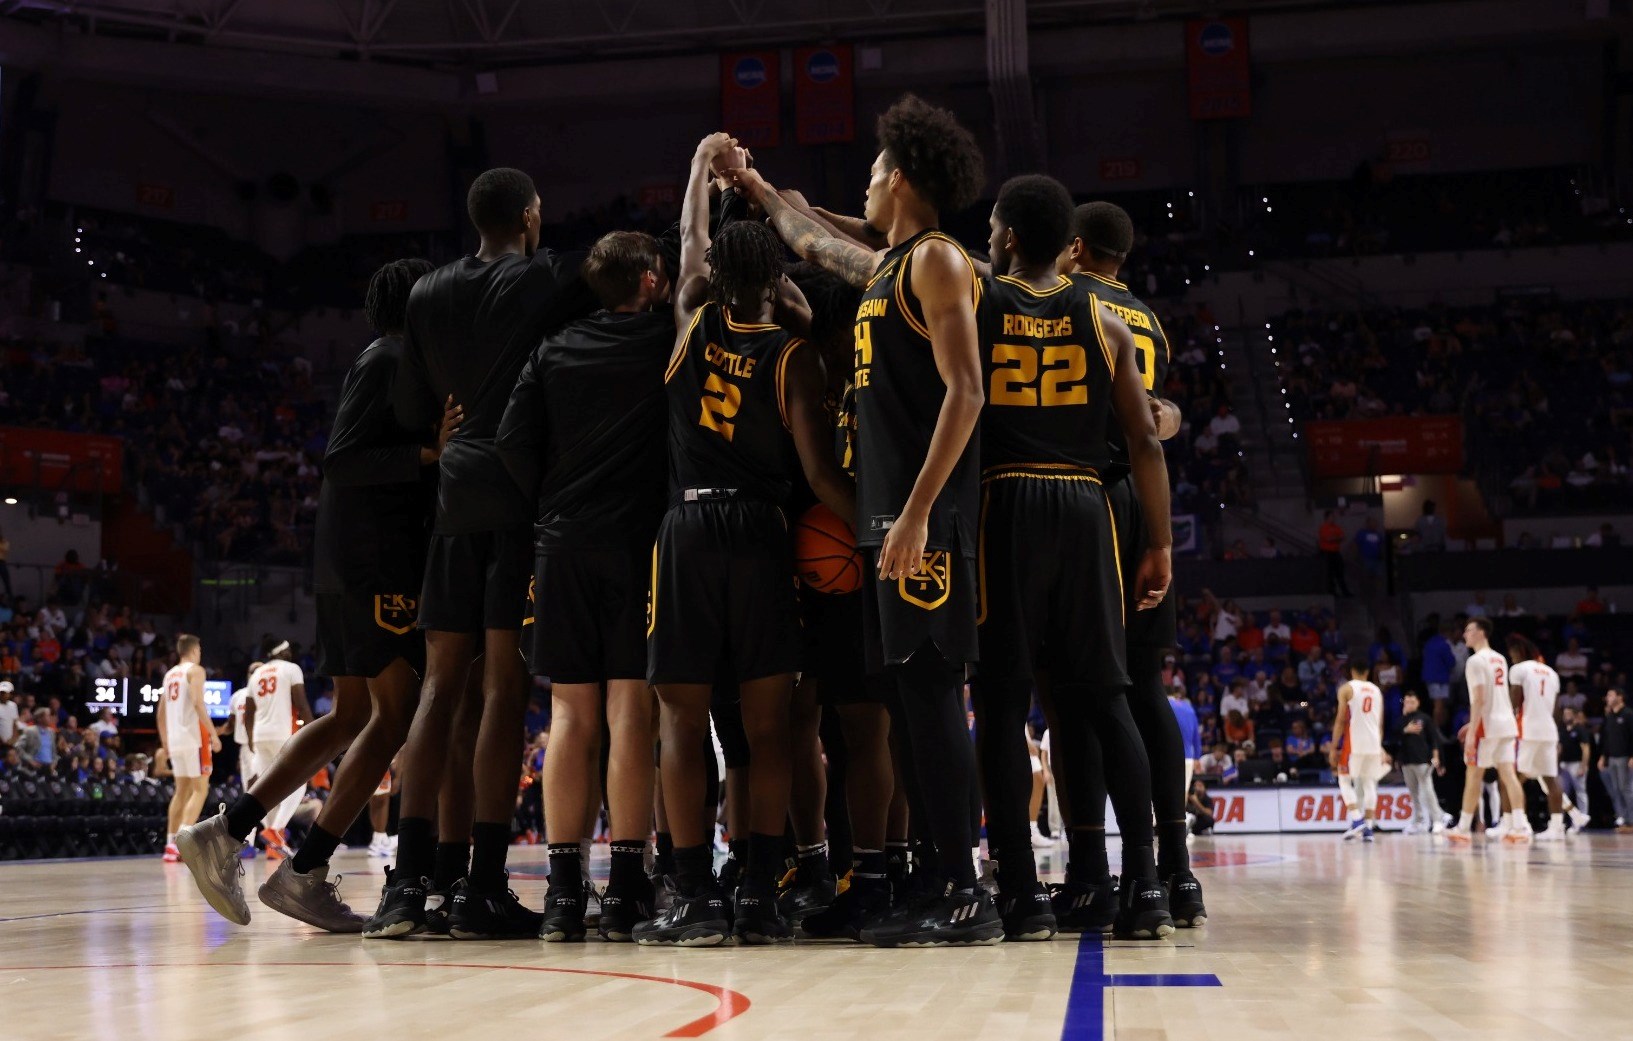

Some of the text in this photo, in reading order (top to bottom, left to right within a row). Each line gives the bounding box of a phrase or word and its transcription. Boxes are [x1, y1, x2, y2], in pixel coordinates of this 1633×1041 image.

[1003, 313, 1073, 338] RODGERS
[704, 341, 757, 378] COTTLE
[990, 343, 1088, 407] 22
[698, 371, 742, 443] 2
[258, 676, 277, 696] 33
[1494, 668, 1504, 686] 2
[96, 686, 116, 702] 34
[168, 682, 179, 701] 13
[1539, 679, 1545, 697] 1
[1362, 697, 1372, 713] 0
[1295, 794, 1413, 822] GATRS
